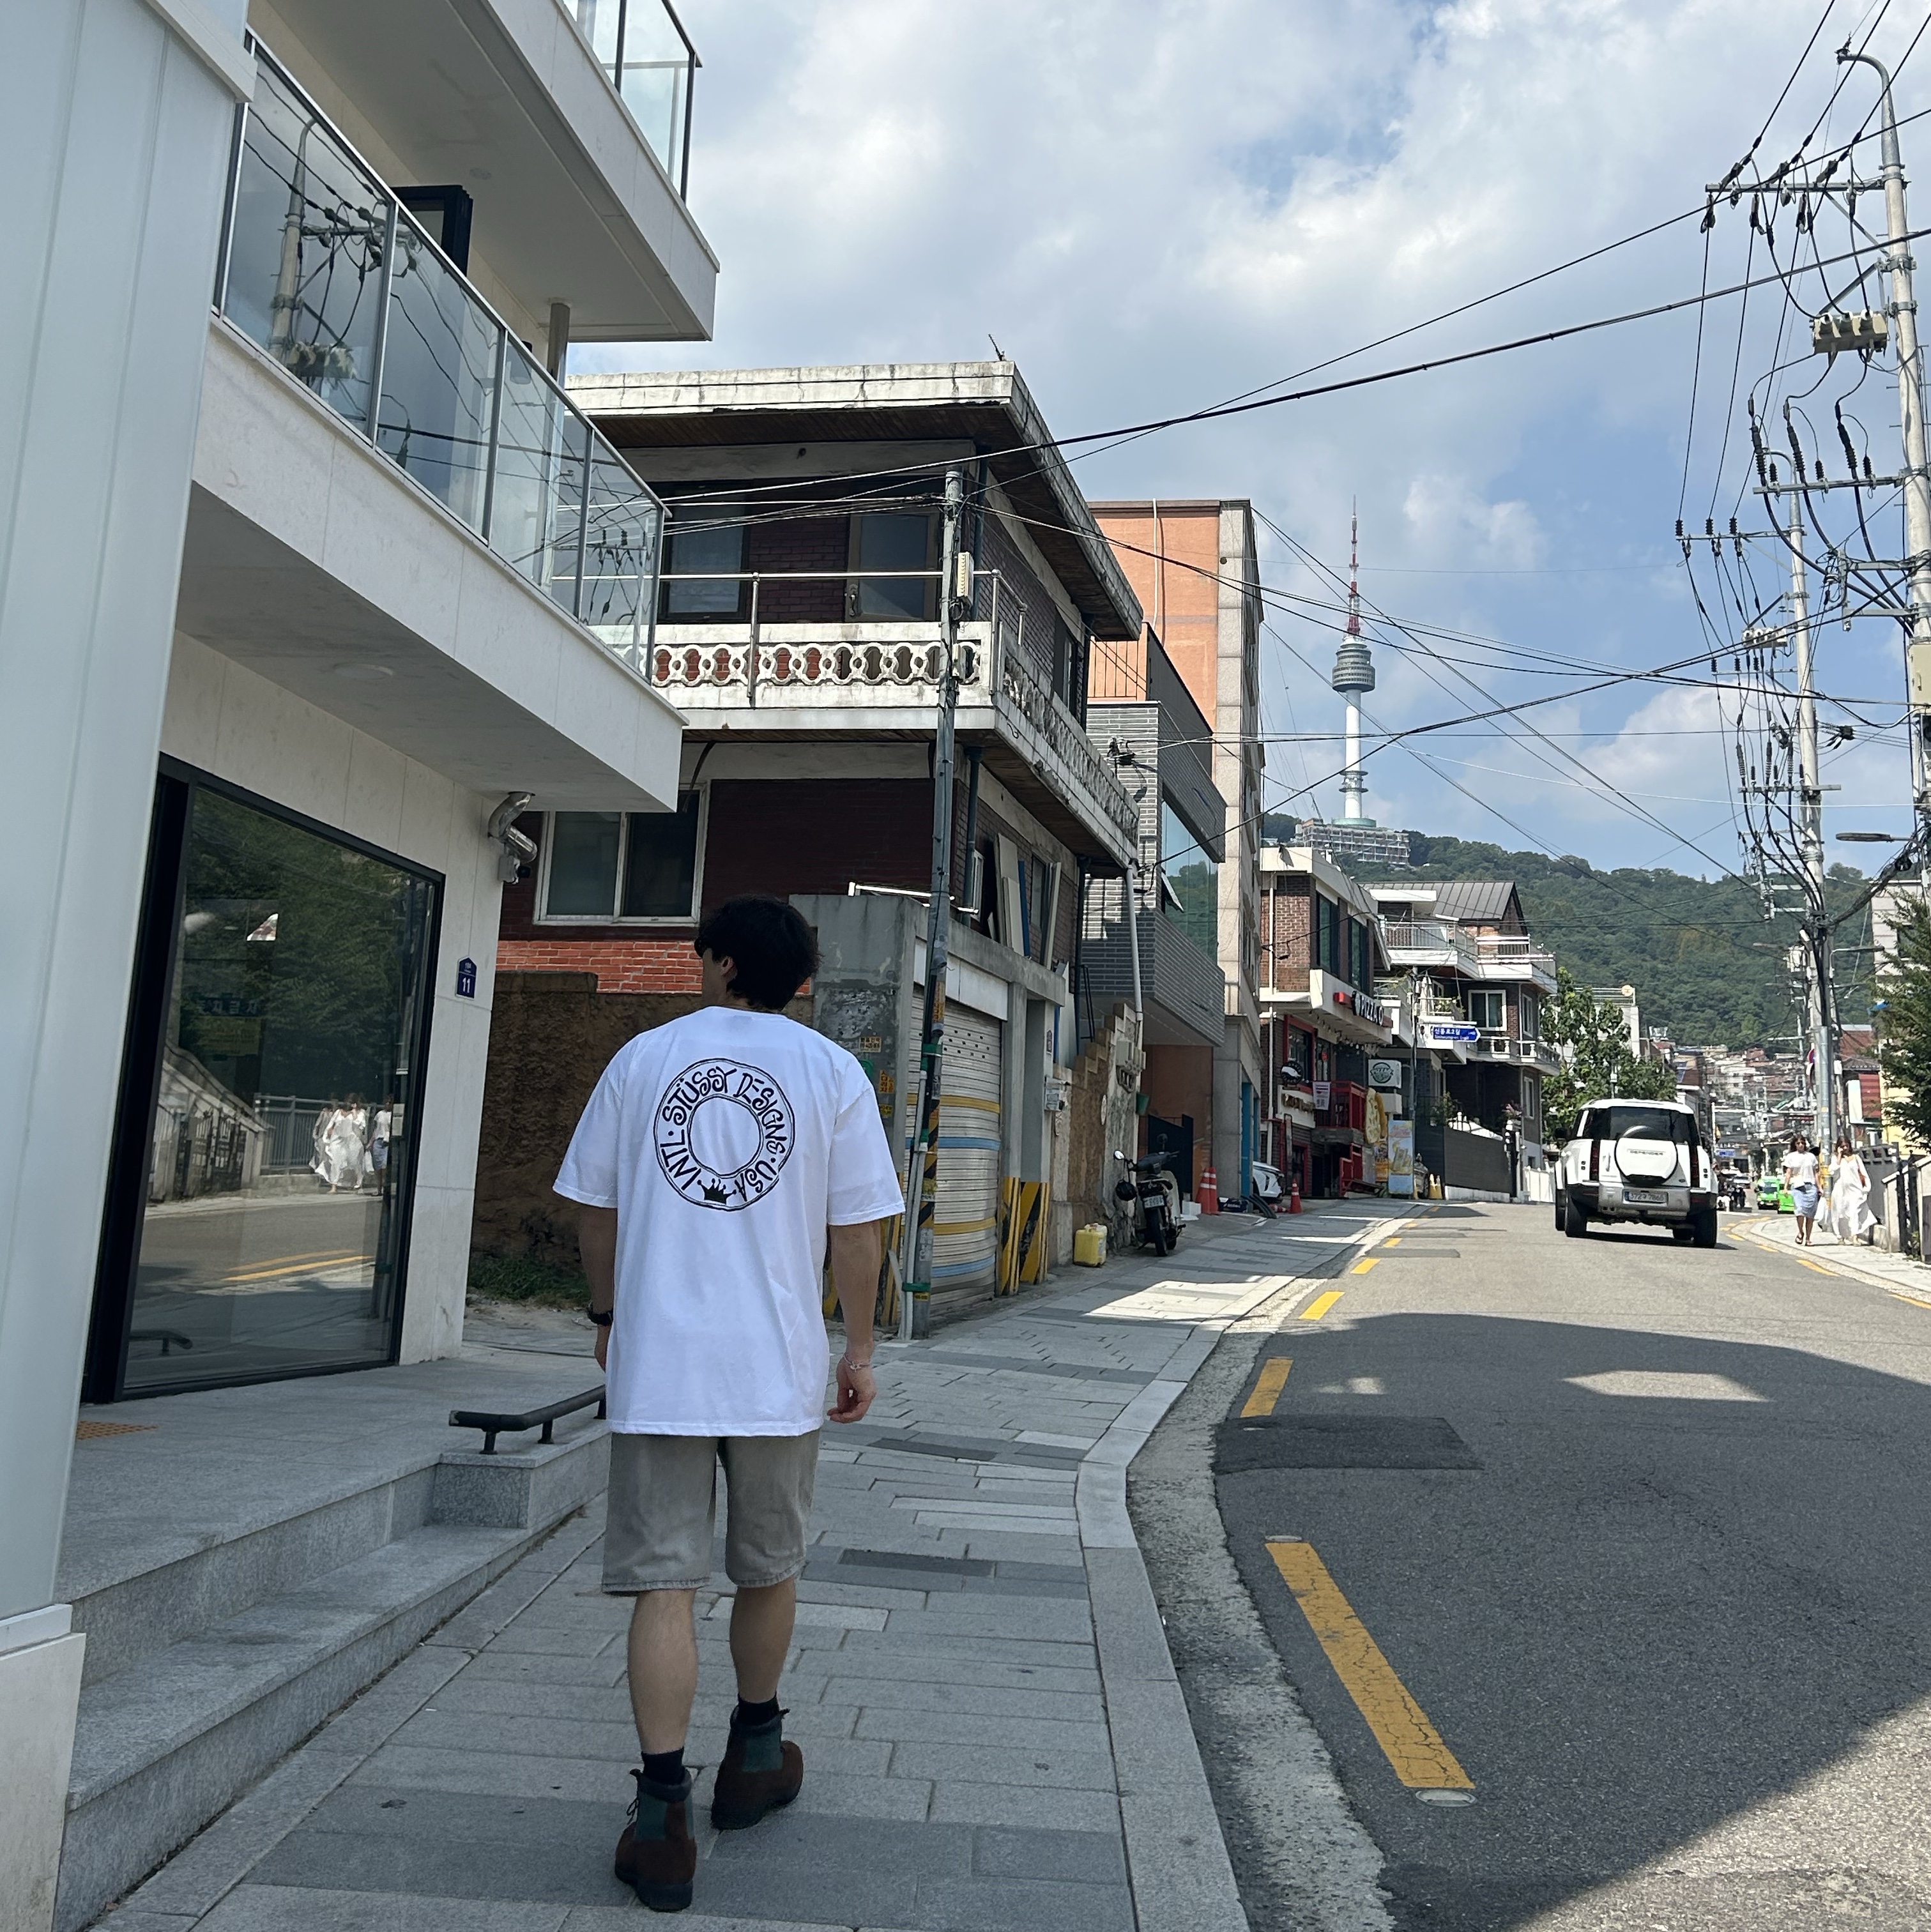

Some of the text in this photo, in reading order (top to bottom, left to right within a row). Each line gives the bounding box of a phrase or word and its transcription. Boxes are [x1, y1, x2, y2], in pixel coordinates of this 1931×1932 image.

[462, 977, 471, 993] 11
[1361, 994, 1378, 1023] PIZZA
[733, 1072, 788, 1155] DESIGNS
[660, 1129, 701, 1190] INTL
[735, 1160, 777, 1202] USA
